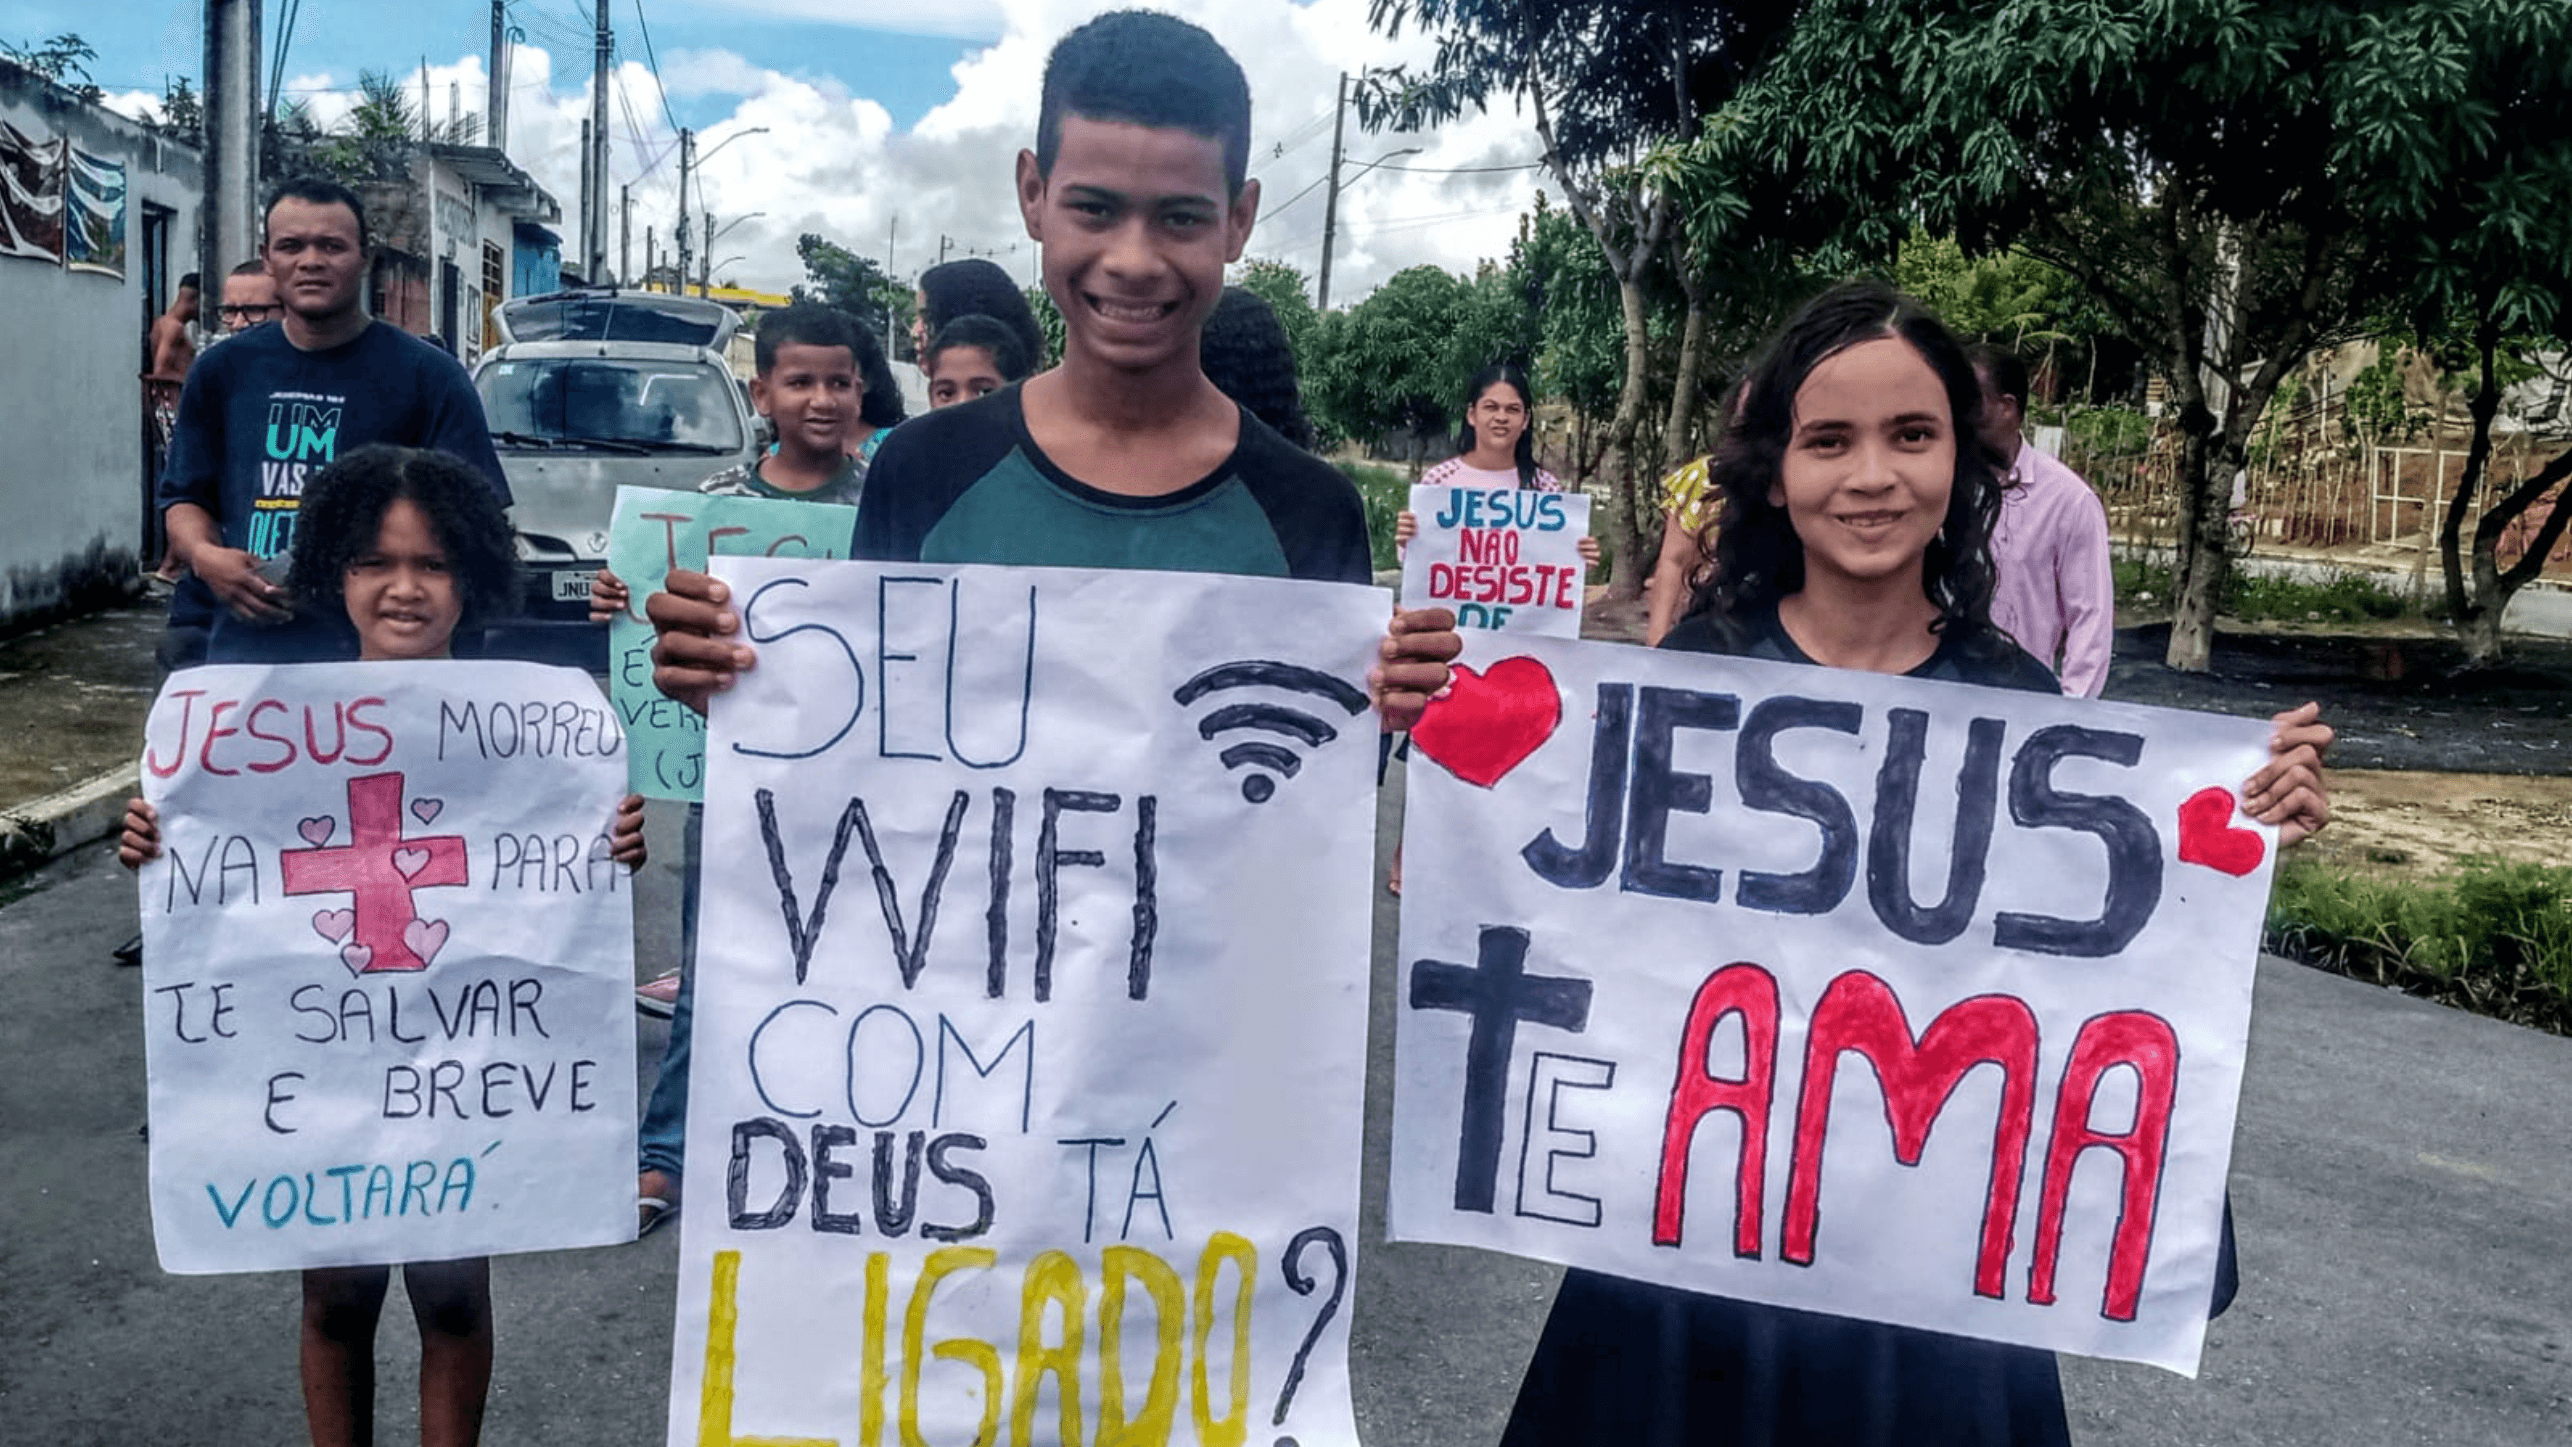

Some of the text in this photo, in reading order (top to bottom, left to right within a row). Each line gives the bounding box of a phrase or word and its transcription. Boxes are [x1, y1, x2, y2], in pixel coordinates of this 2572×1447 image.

[1436, 488, 1566, 531] JESUS
[1429, 563, 1575, 609] DESISTE
[732, 574, 1037, 768] SEU
[147, 690, 623, 777] JESUS MORREU
[1521, 682, 2163, 957] JESUS
[167, 832, 615, 914] NA PARA
[755, 787, 1156, 1002] WIFI
[155, 979, 551, 1043] TE SALVAR
[265, 1060, 597, 1134] E BREVE
[749, 1000, 1035, 1134] COM
[206, 1140, 502, 1230] VOLTARÁ
[726, 1100, 1178, 1243] DEUS TÁ
[1652, 961, 2181, 1323] AMA
